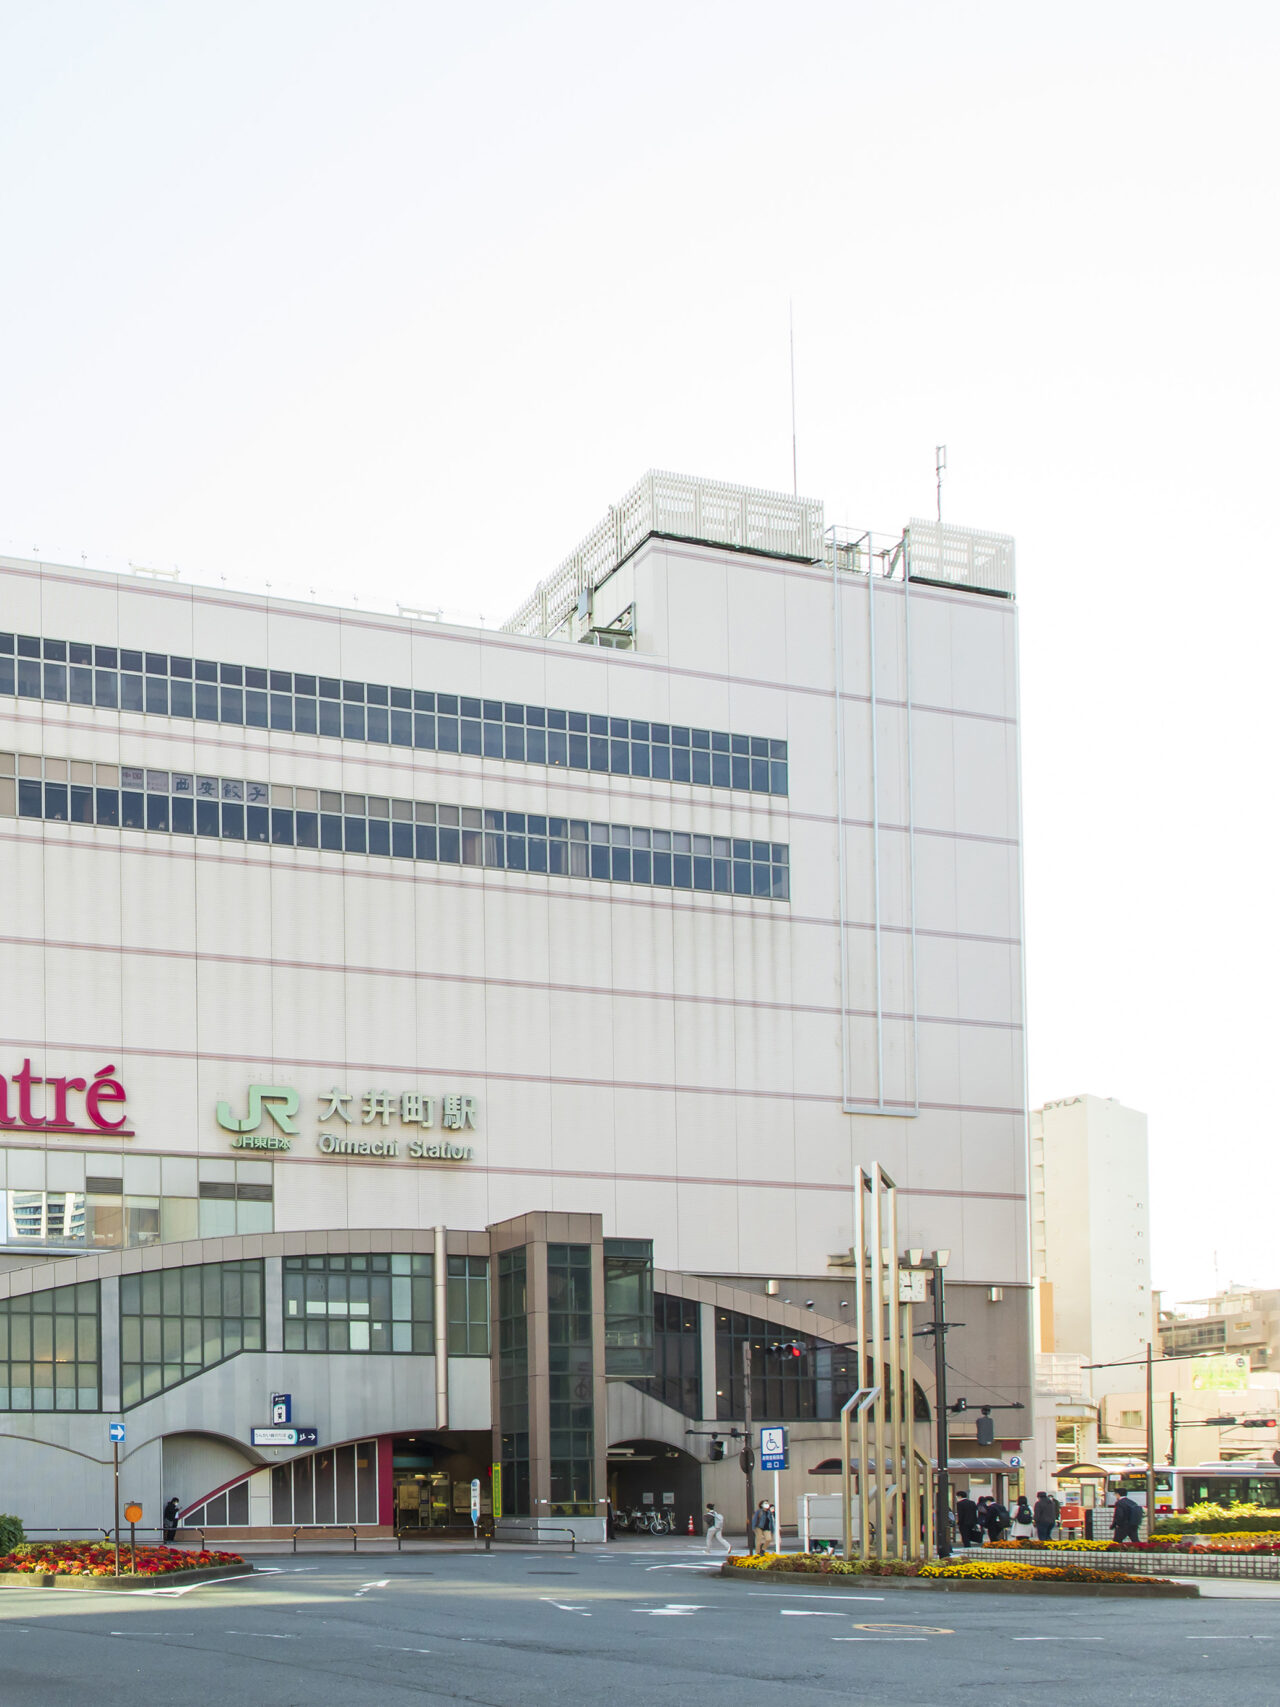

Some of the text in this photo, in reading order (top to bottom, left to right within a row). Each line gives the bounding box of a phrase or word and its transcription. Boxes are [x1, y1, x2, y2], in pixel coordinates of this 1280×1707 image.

[216, 1085, 300, 1134] JR
[318, 1087, 476, 1129] 大井町駅
[231, 1136, 291, 1149] JR東日本
[408, 1140, 474, 1161] Station
